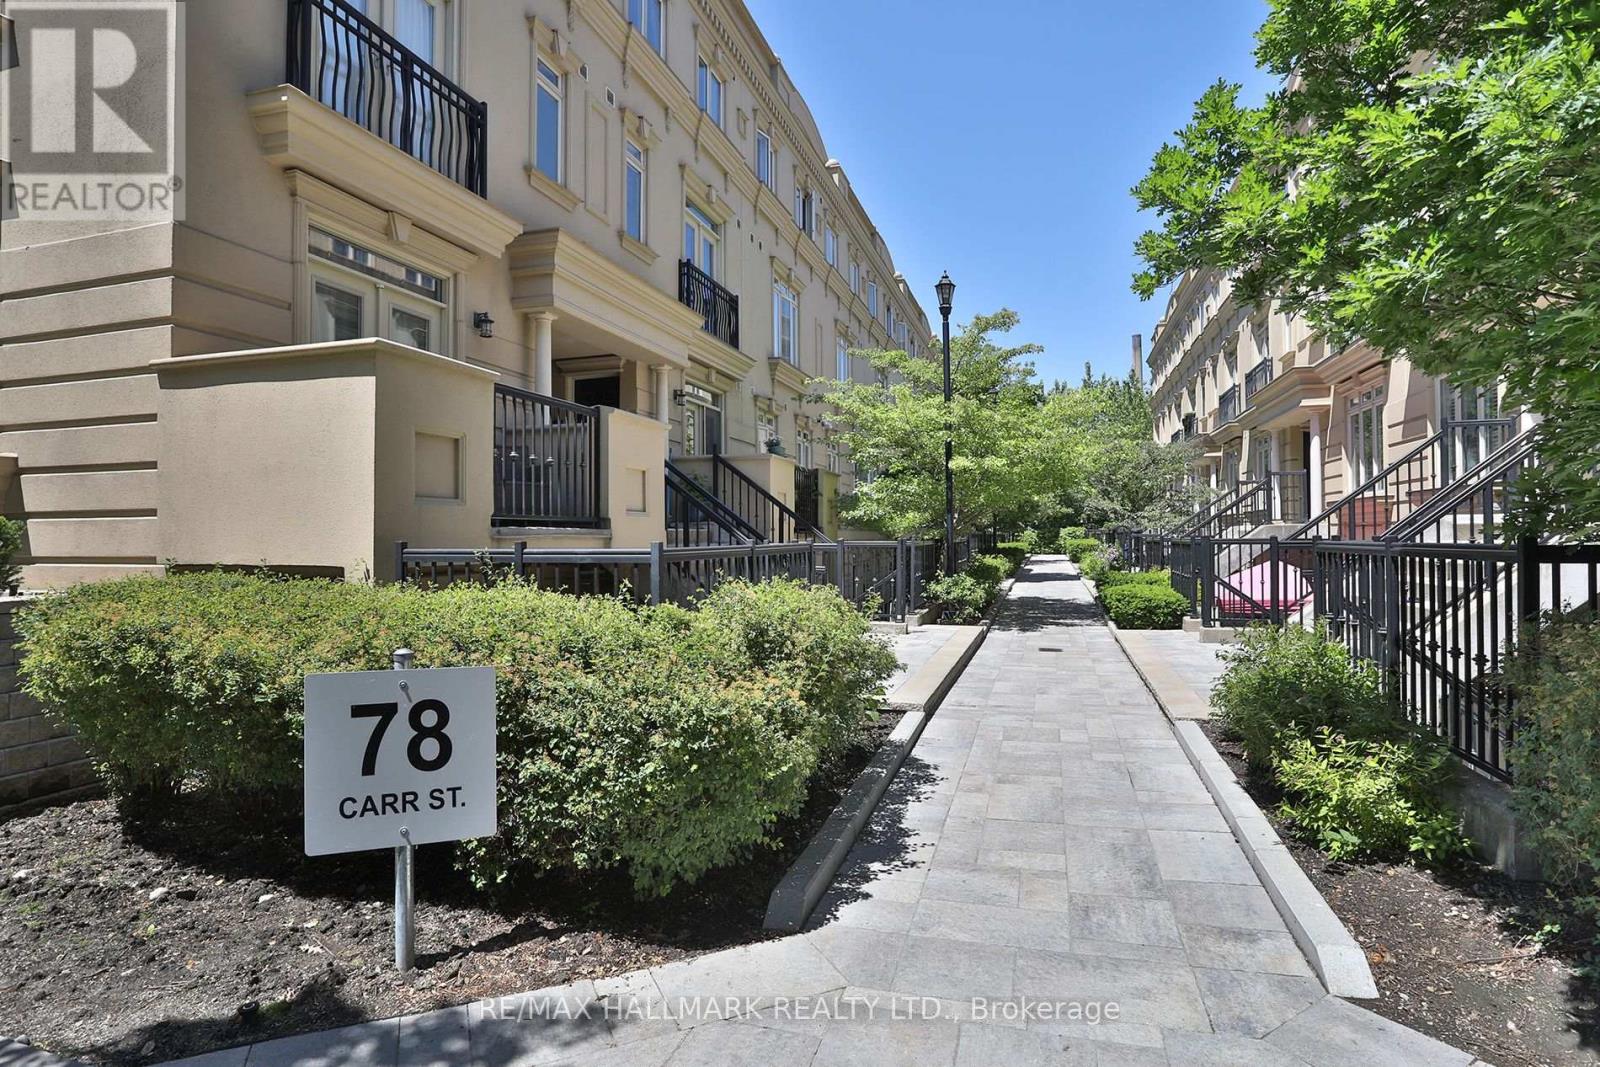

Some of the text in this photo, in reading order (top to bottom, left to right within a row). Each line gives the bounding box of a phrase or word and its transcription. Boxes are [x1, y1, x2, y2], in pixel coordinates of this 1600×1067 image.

[350, 698, 453, 776] 78
[338, 786, 466, 820] CARR ST.
